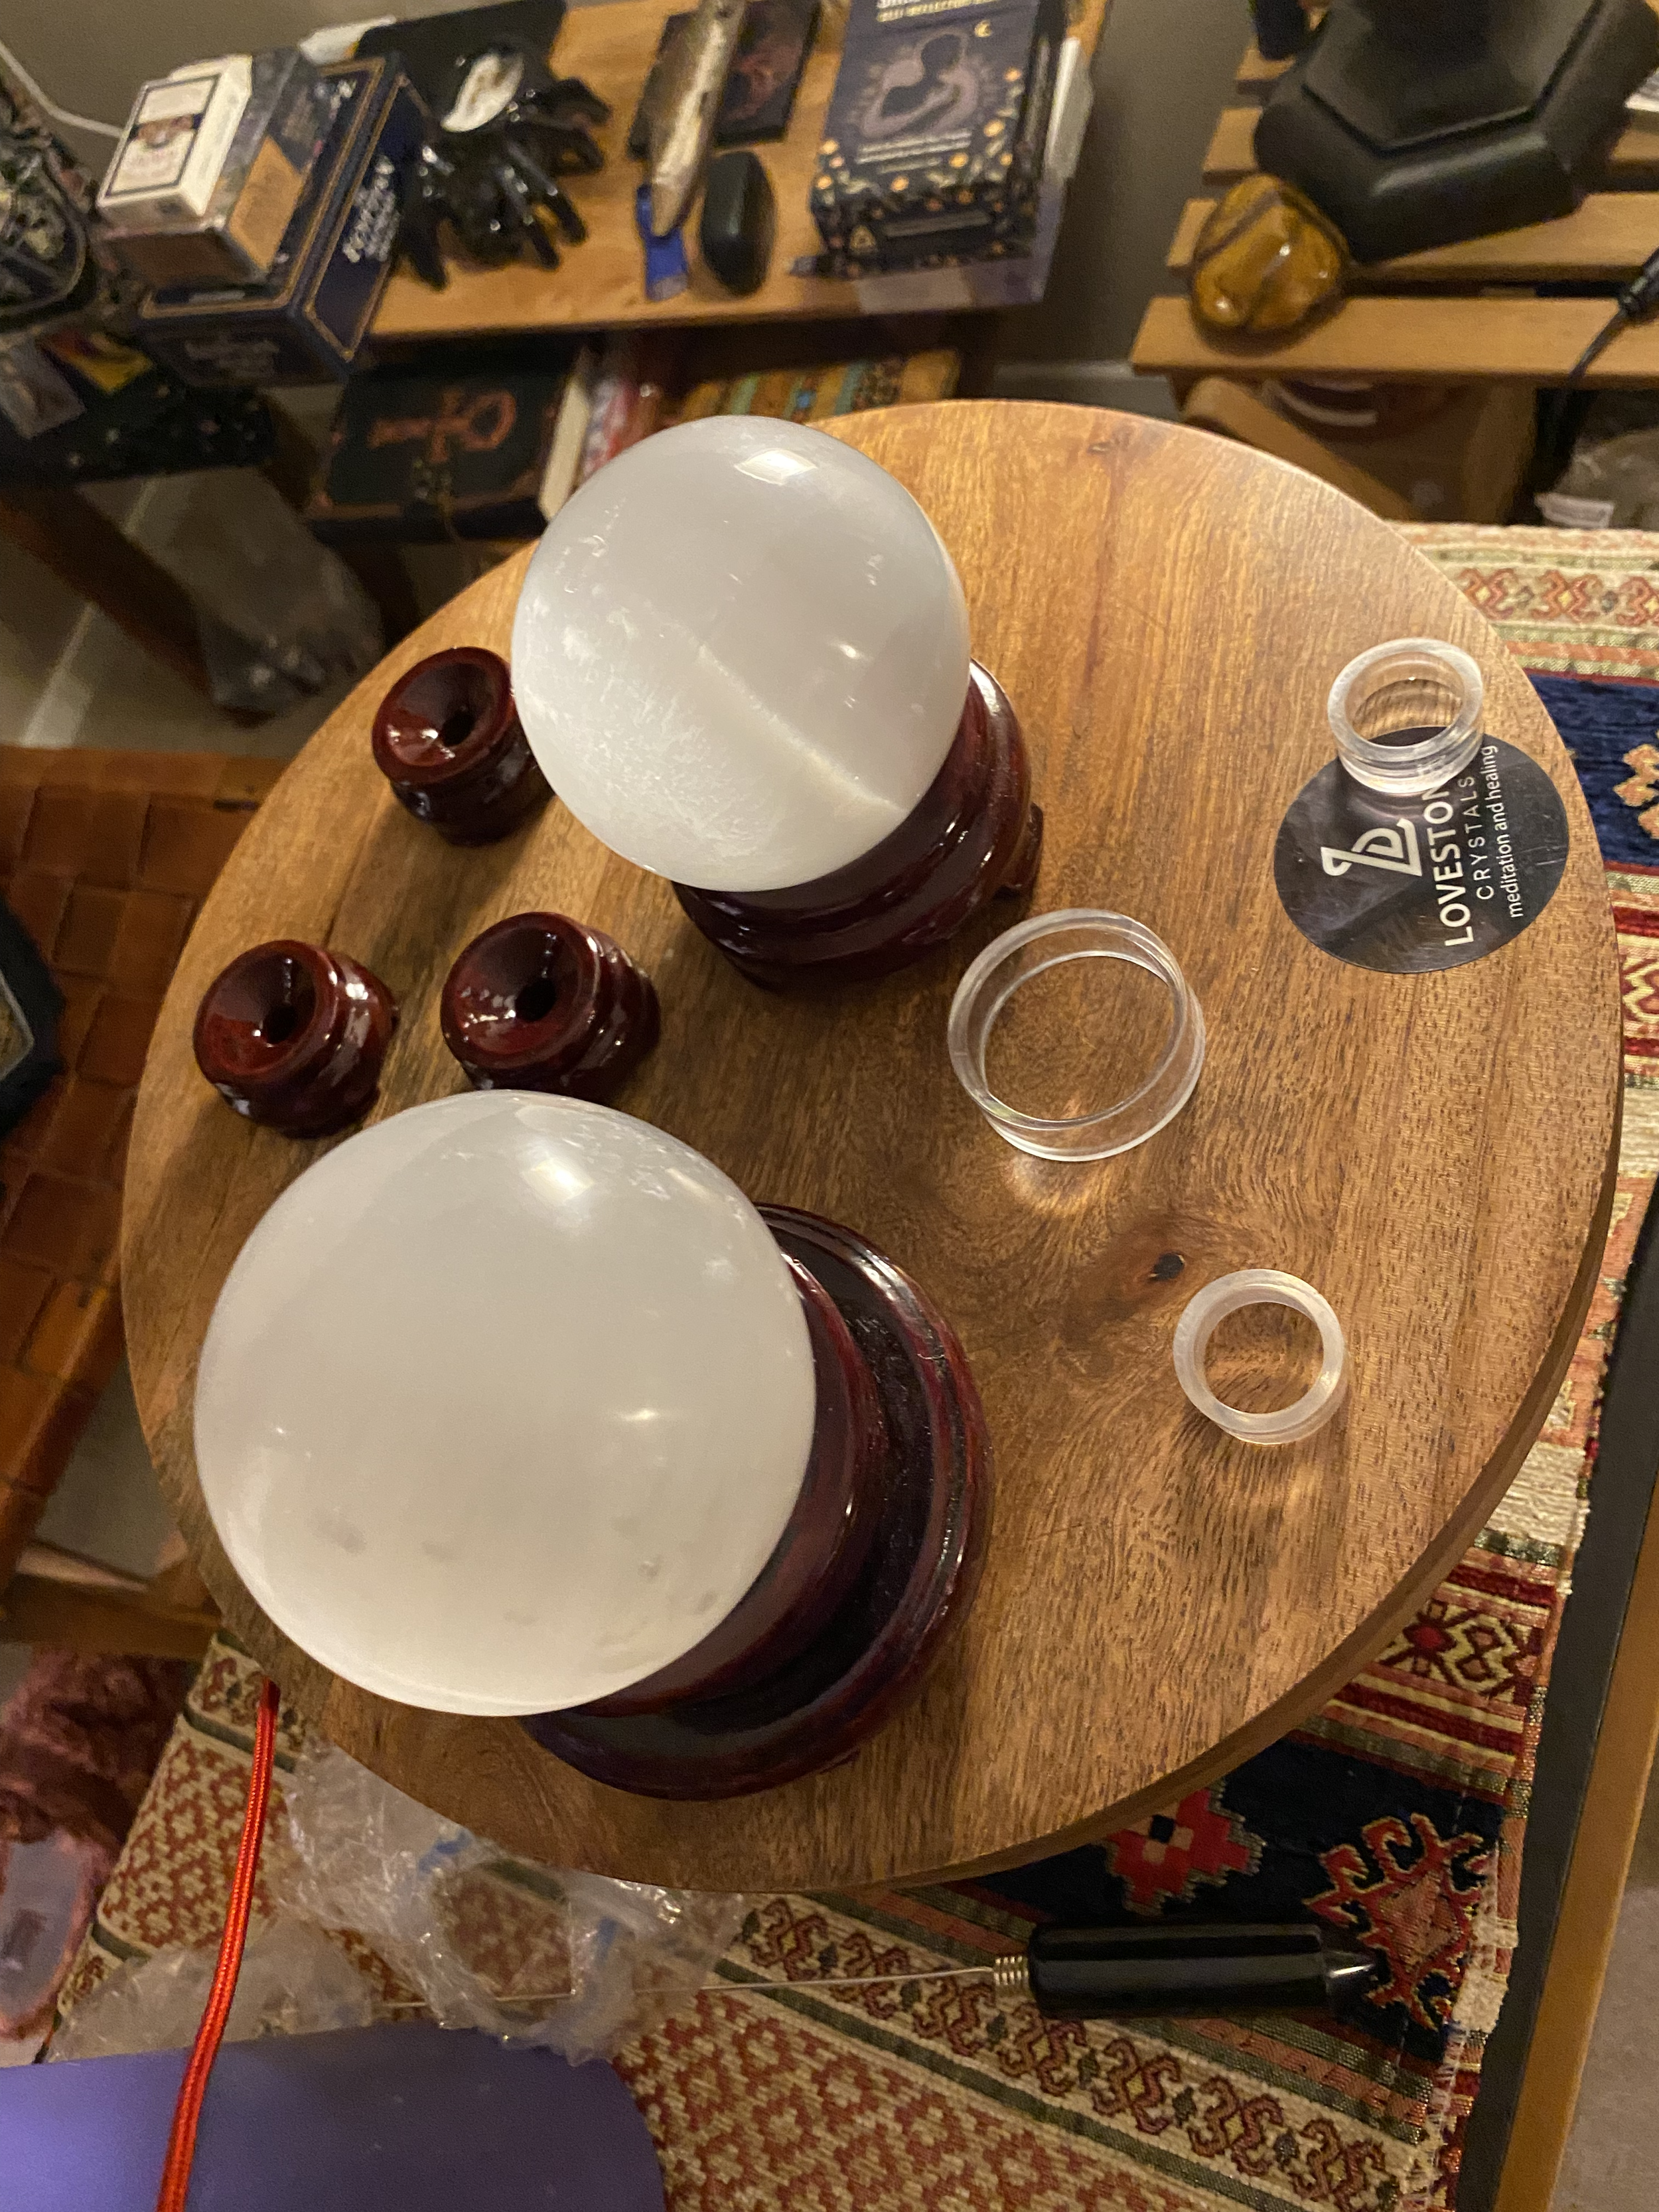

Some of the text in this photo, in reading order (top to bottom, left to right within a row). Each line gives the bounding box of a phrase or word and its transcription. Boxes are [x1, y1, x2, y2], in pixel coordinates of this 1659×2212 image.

[1422, 784, 1474, 946] LOVESTON
[1458, 776, 1494, 900] CRYSTALS
[1480, 745, 1524, 918] meditation and healing
